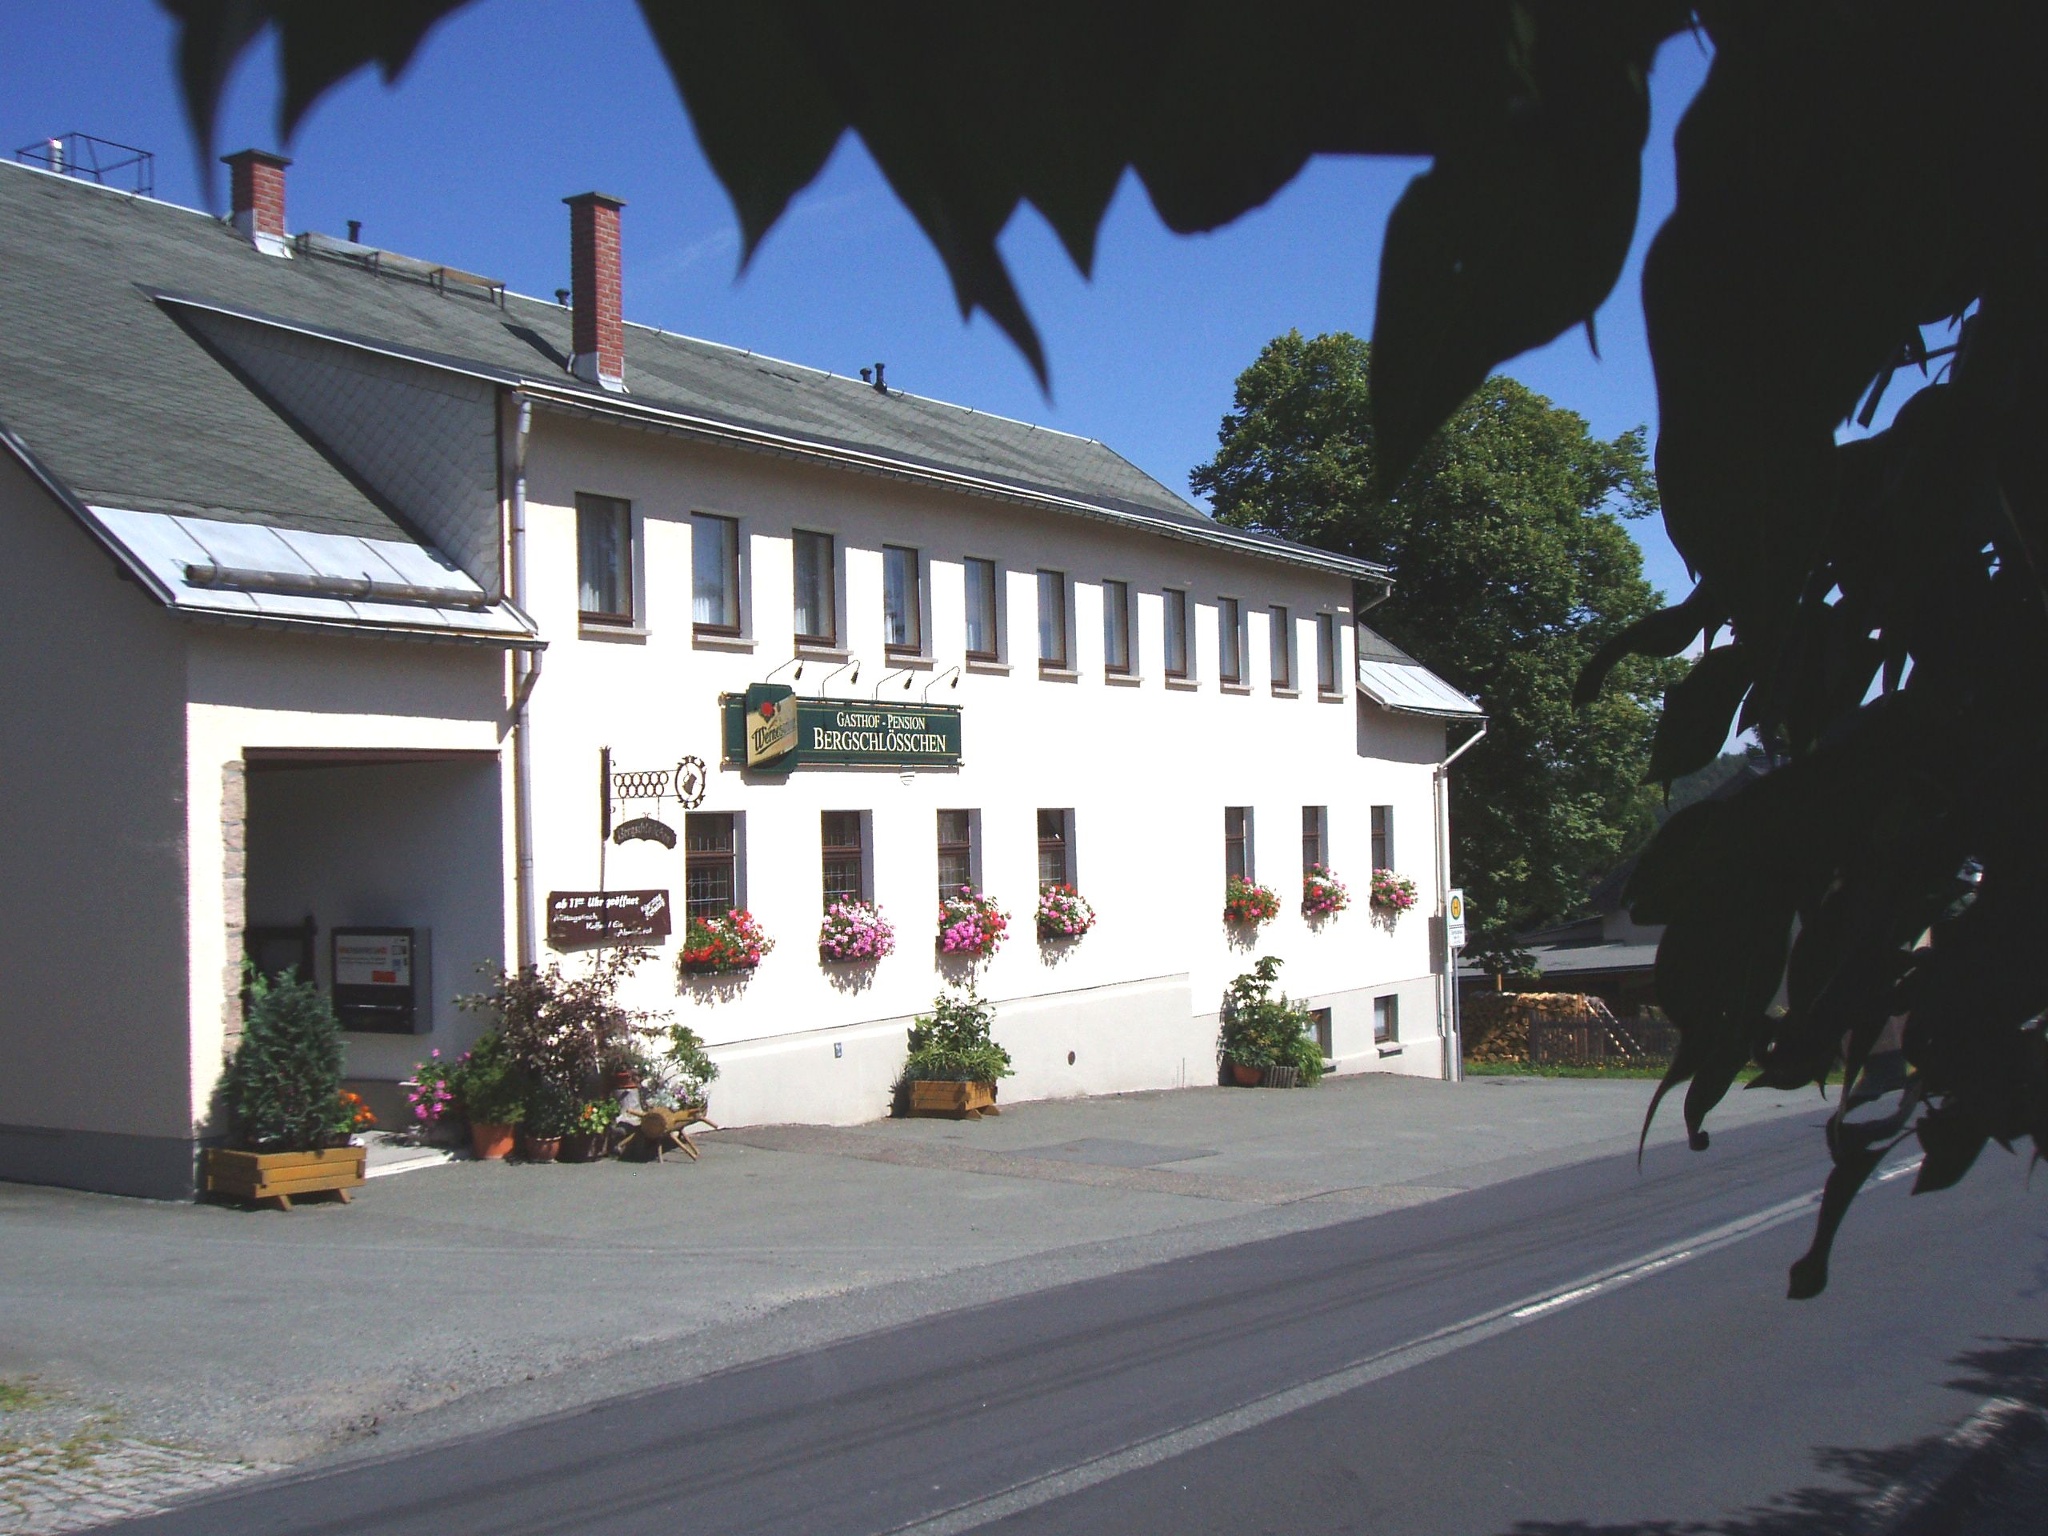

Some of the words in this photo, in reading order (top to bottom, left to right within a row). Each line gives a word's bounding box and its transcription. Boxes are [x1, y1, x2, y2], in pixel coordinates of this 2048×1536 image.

[836, 711, 880, 728] GASTHOF
[887, 714, 926, 730] PENSION
[813, 727, 946, 752] BERGSCHLÖSSCHEN
[587, 896, 604, 908] Uhr
